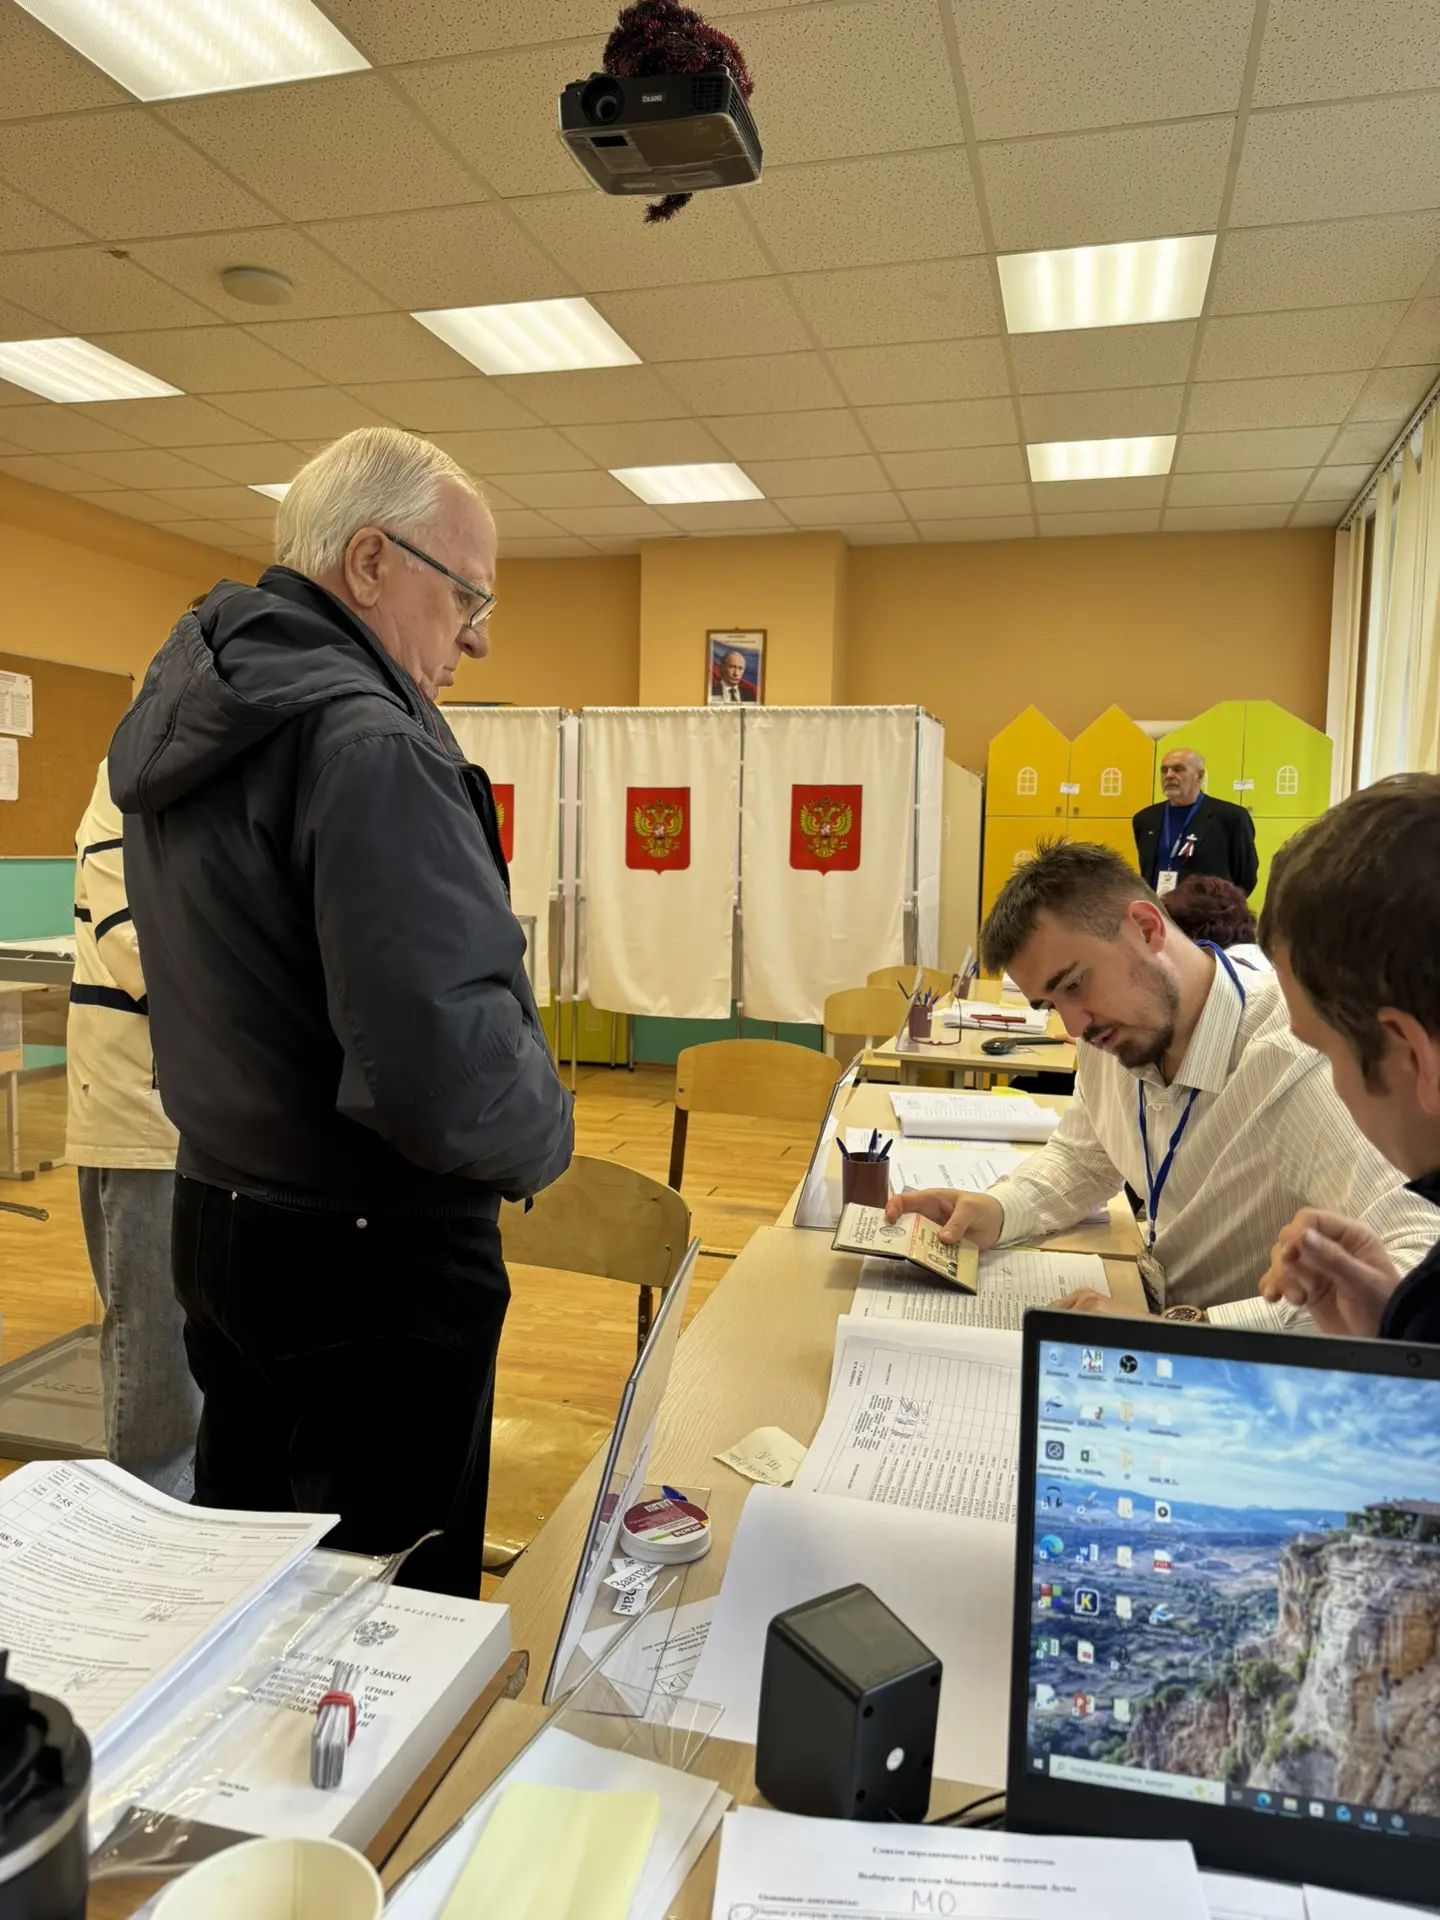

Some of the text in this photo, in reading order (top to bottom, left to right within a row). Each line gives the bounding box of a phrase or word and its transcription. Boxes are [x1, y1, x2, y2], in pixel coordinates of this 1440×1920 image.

[611, 1563, 657, 1589] Завтрак
[1080, 1593, 1093, 1610] K
[370, 1667, 412, 1683] ЗАКОН
